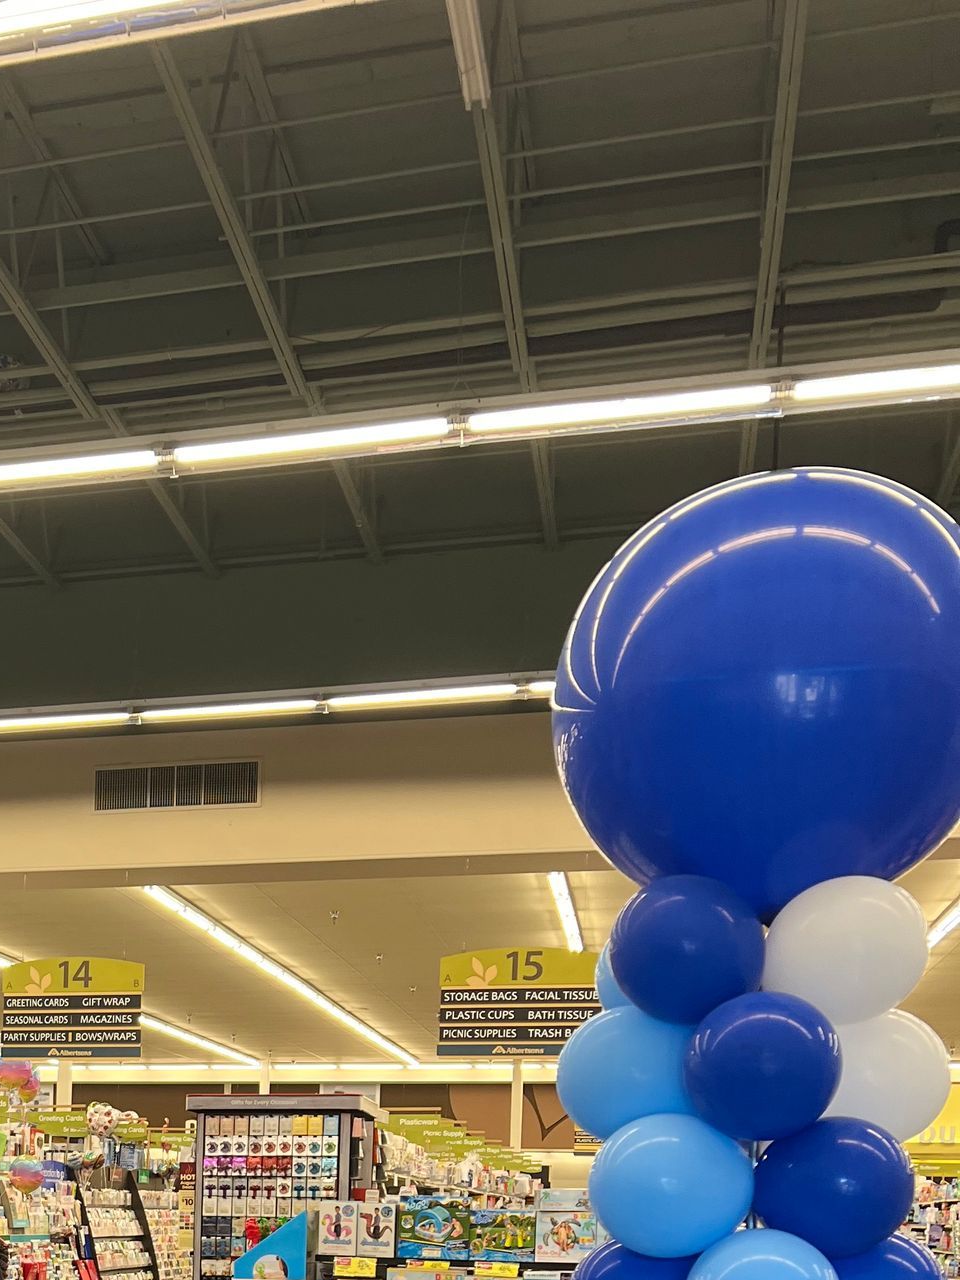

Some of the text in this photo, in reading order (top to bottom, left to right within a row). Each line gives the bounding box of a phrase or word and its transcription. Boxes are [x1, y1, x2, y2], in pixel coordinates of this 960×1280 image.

[506, 951, 544, 981] 15
[58, 960, 93, 989] 14
[444, 990, 599, 1001] STORAGE BAGS FACIAL TISSUE
[6, 997, 131, 1007] GREETING CARDS GIFT WRAP
[5, 1014, 133, 1025] SEASONAL CARDS MAGAZINES
[445, 1010, 593, 1020] PLASTIC CUPS BATH TISSUE
[3, 1032, 137, 1042] PARTY SUPPLIES BOWS/WRAPS
[442, 1028, 576, 1039] PICNIC SUPPLIES TRASH BA
[38, 1114, 65, 1123] Greeting
[399, 1118, 439, 1126] Plasticware
[442, 1130, 465, 1138] Supply
[180, 1173, 196, 1181] HOT
